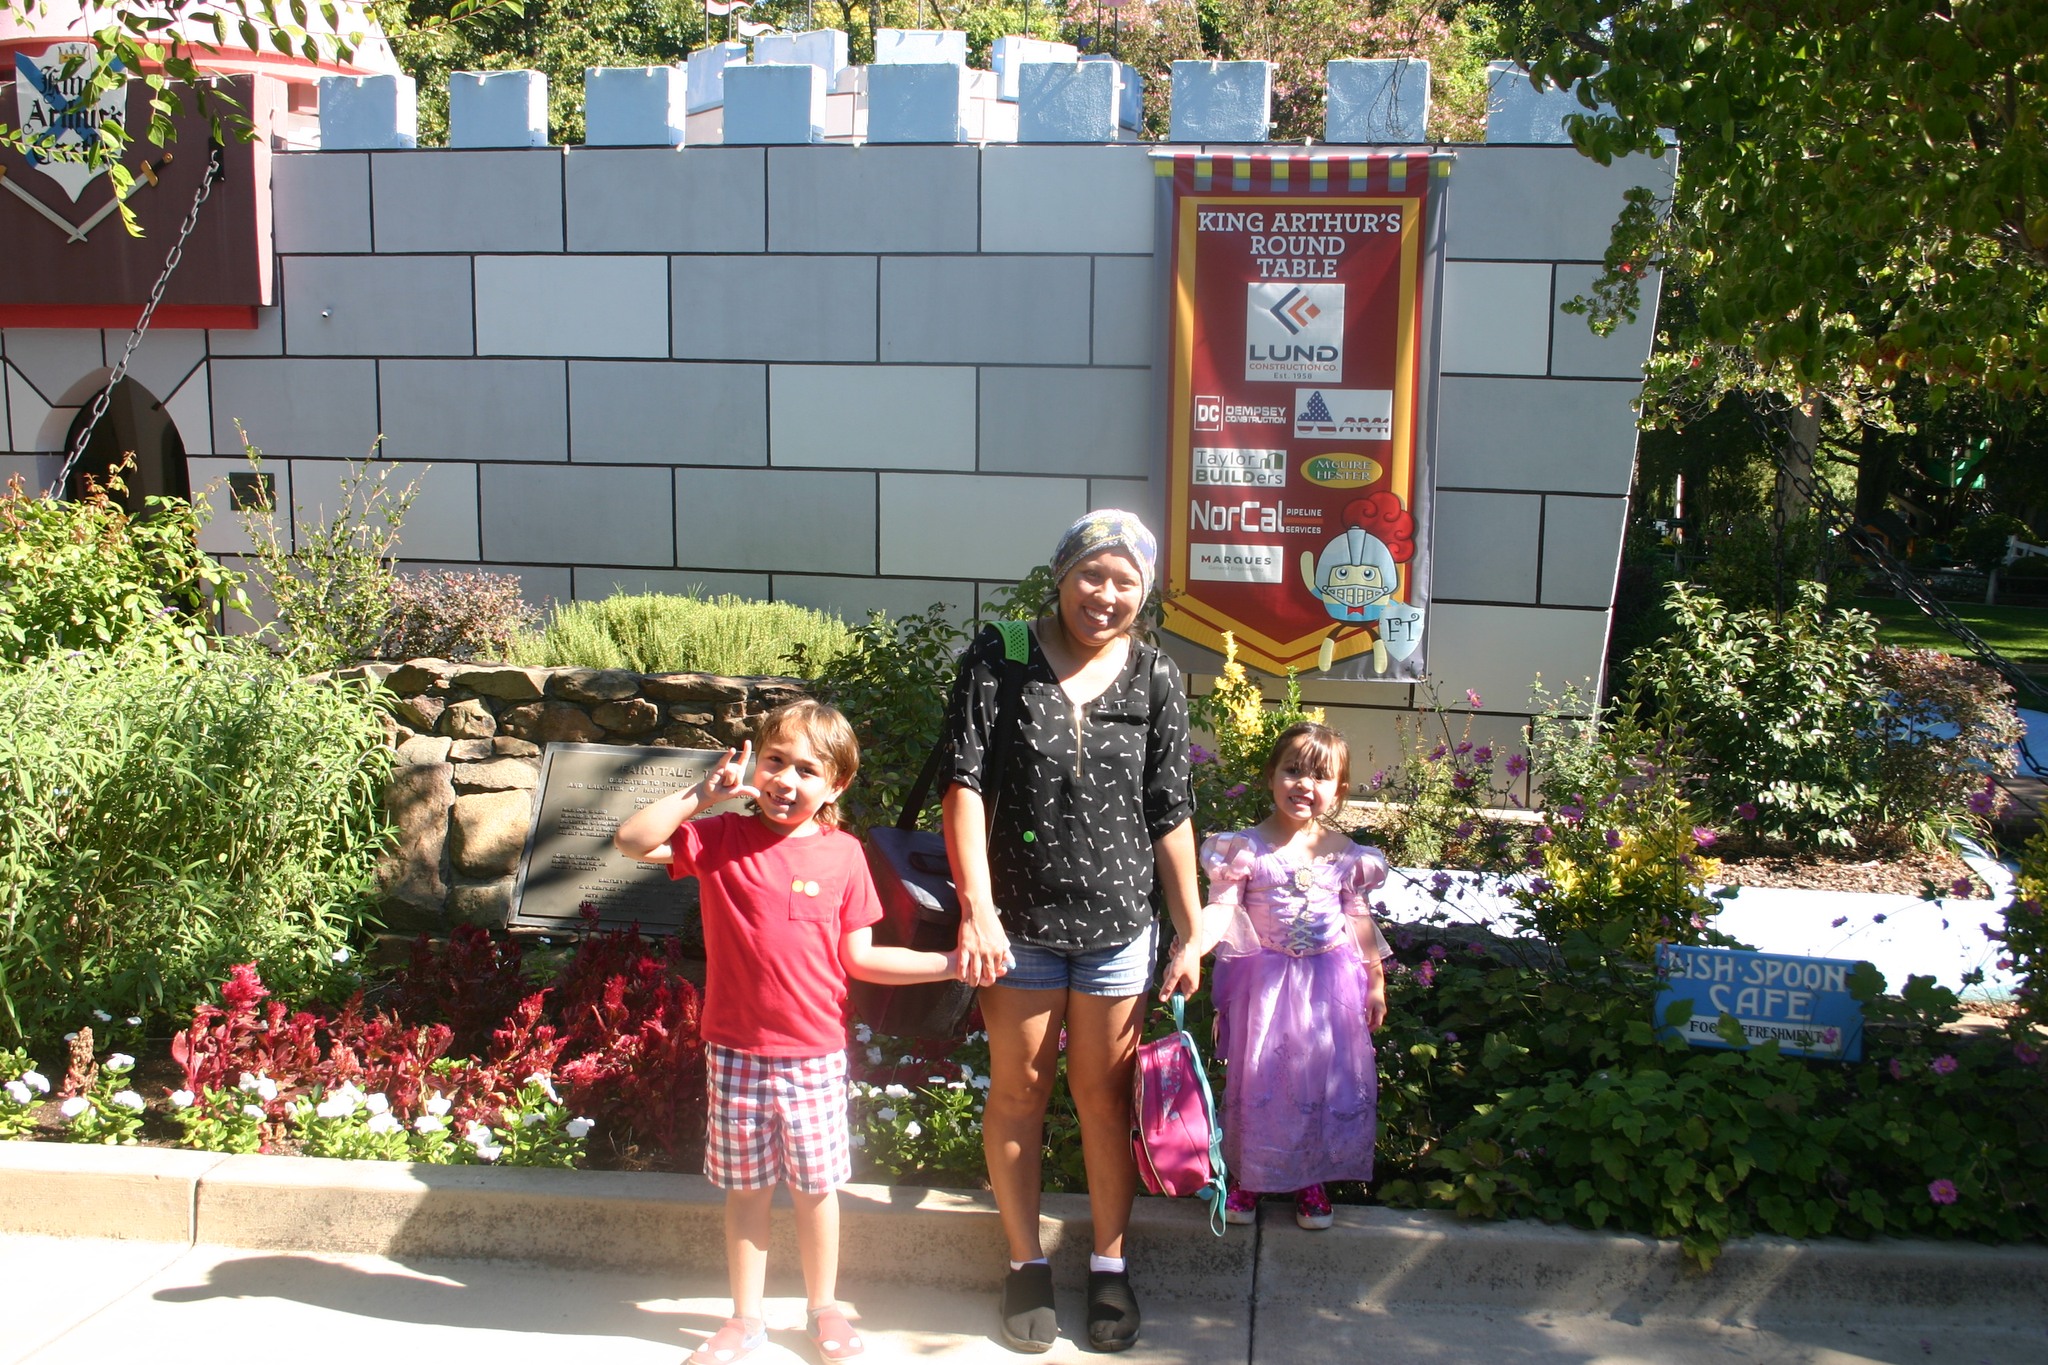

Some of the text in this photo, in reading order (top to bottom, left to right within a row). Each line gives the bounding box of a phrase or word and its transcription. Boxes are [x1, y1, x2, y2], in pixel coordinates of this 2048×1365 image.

[1198, 212, 1401, 233] KING ARTHUR'S
[1250, 236, 1346, 256] ROUND
[1257, 259, 1337, 278] TABLE
[1249, 344, 1339, 362] LUND
[1249, 363, 1338, 372] CONSTRUCTION CO.
[1198, 404, 1220, 422] DC
[1225, 405, 1286, 417] DEMPSEY
[1225, 415, 1287, 424] CONSTRUCTION
[1197, 450, 1255, 467] Taylor
[1195, 469, 1283, 484] BUILDers
[1316, 471, 1371, 481] HESTER
[1190, 499, 1285, 532] NorCal
[1286, 508, 1322, 516] PIPELINE
[1201, 555, 1272, 565] MARQUES
[1386, 613, 1420, 642] FT
[1743, 959, 1848, 992] SPOON
[1709, 984, 1813, 1020] CAFE
[1741, 1024, 1822, 1043] EFRESHMENT
